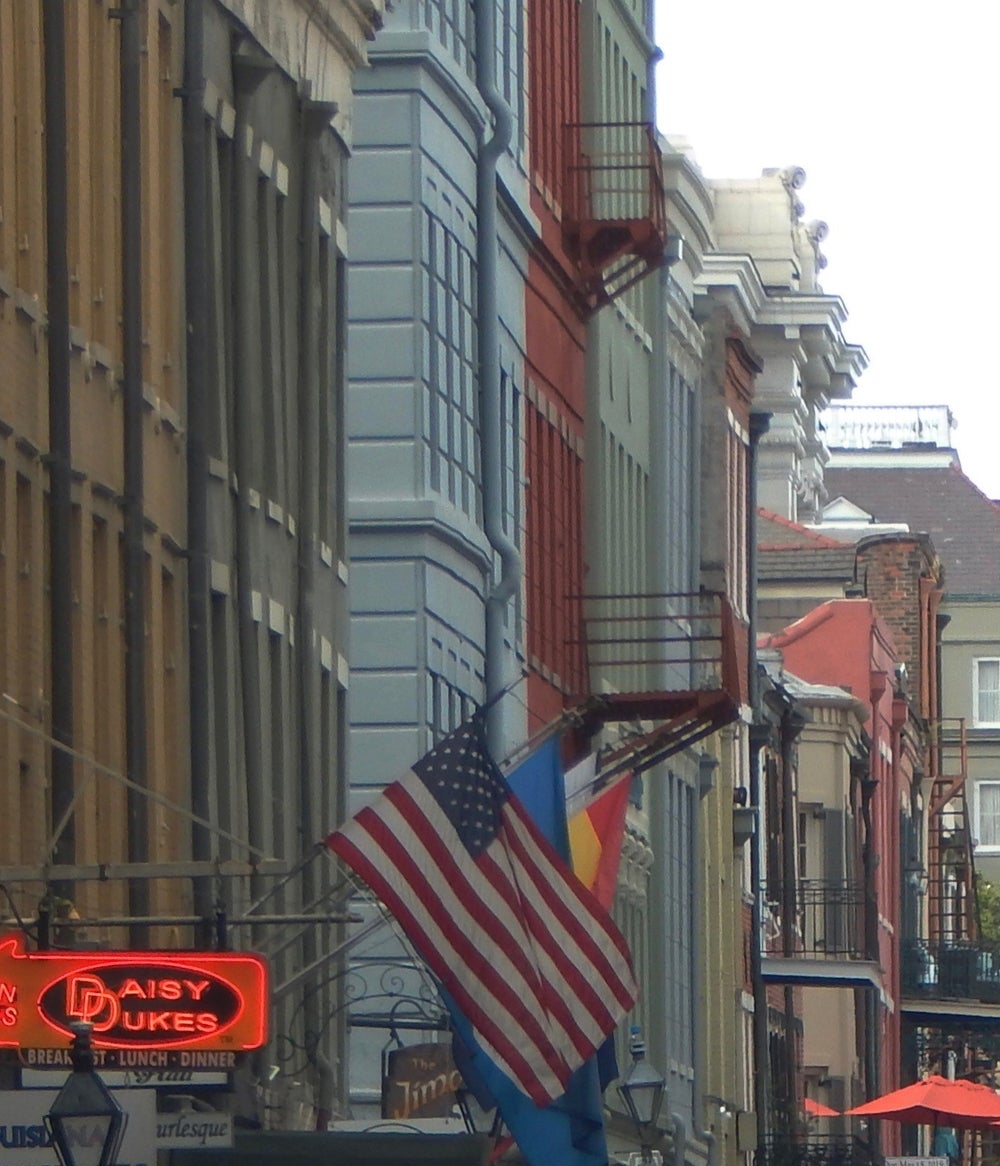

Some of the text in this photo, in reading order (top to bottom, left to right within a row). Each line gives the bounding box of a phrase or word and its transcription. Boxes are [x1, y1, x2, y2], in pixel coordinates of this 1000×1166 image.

[66, 975, 211, 1018] DAISY
[83, 991, 219, 1033] DUKES
[28, 1049, 236, 1068] BREAKST LUNCH DINNER
